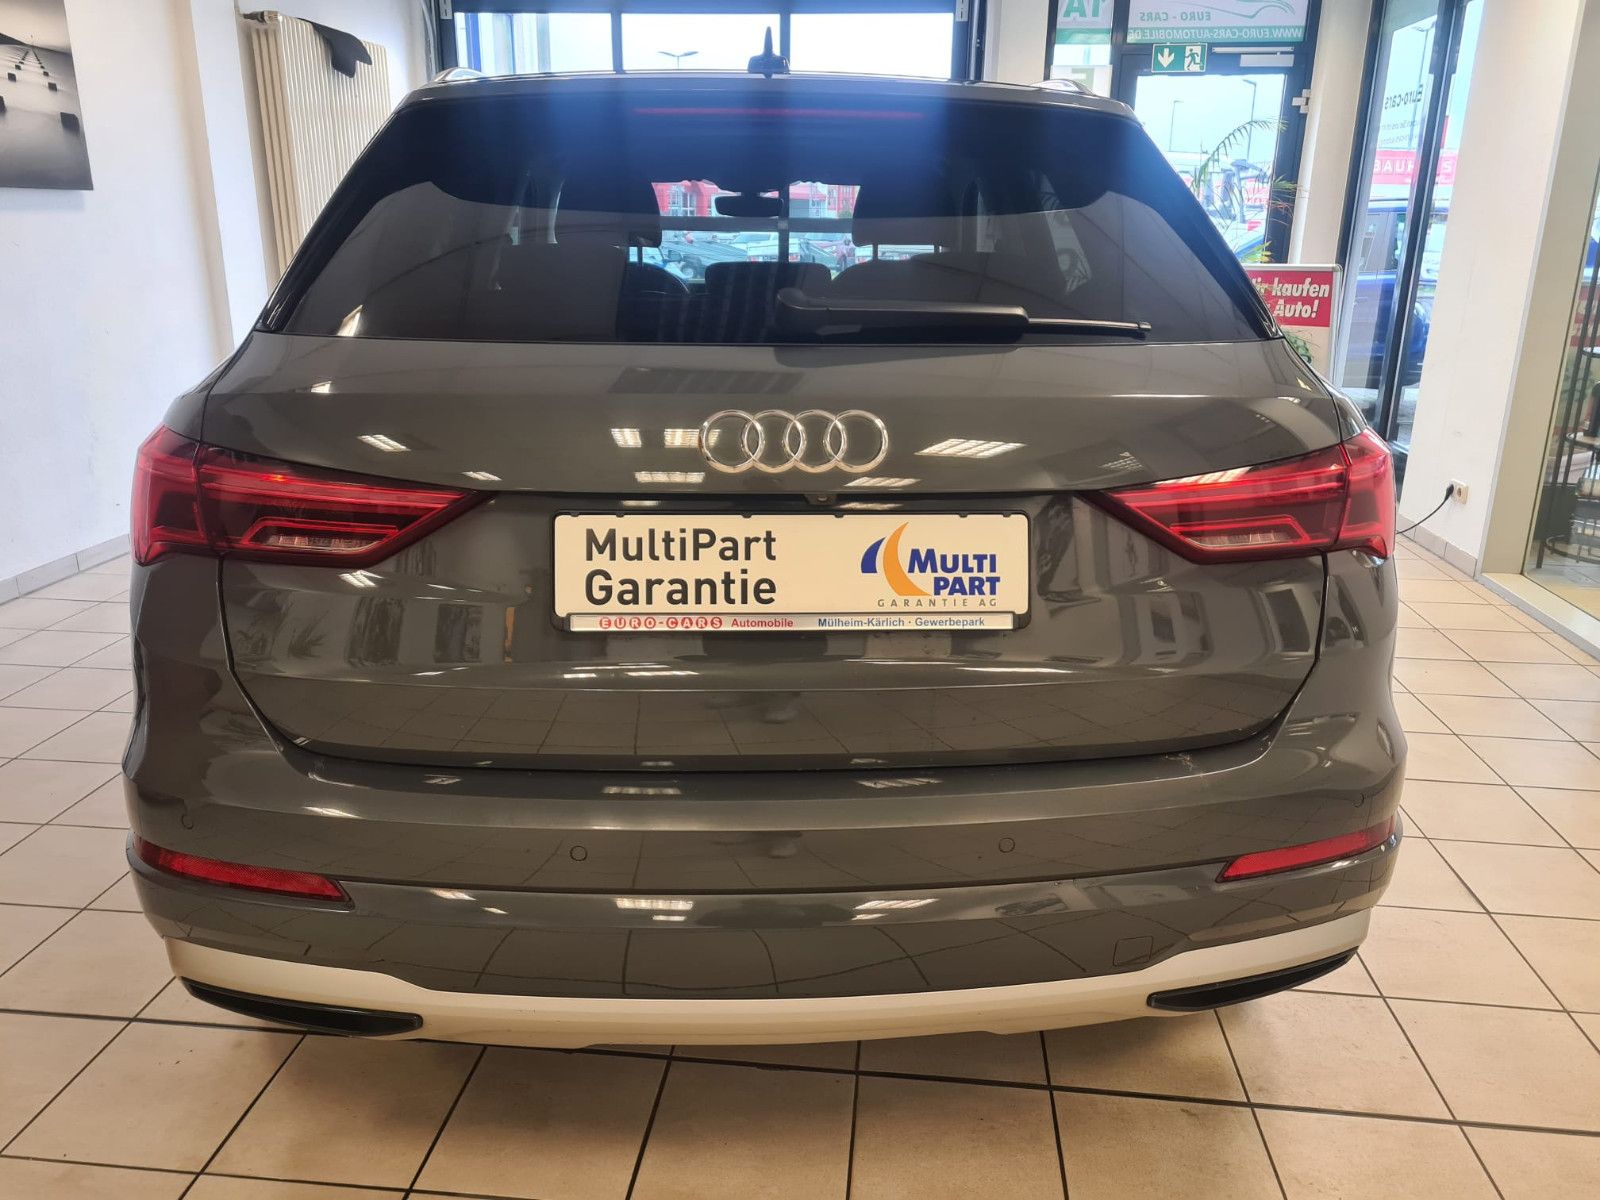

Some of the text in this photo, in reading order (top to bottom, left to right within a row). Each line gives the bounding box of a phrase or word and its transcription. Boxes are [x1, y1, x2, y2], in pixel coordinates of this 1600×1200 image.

[1271, 277, 1330, 298] kaufen
[1272, 298, 1319, 319] Auto!
[585, 527, 777, 562] MultiPart
[908, 548, 997, 574] MULTI
[585, 568, 777, 606] Garantie
[933, 576, 1000, 596] PART
[877, 598, 998, 607] GARANTIE AG
[599, 616, 794, 629] EURO-CARS Automobile
[818, 616, 905, 628] Mülheim-Kärlich
[915, 617, 985, 629] Gewerbepark
